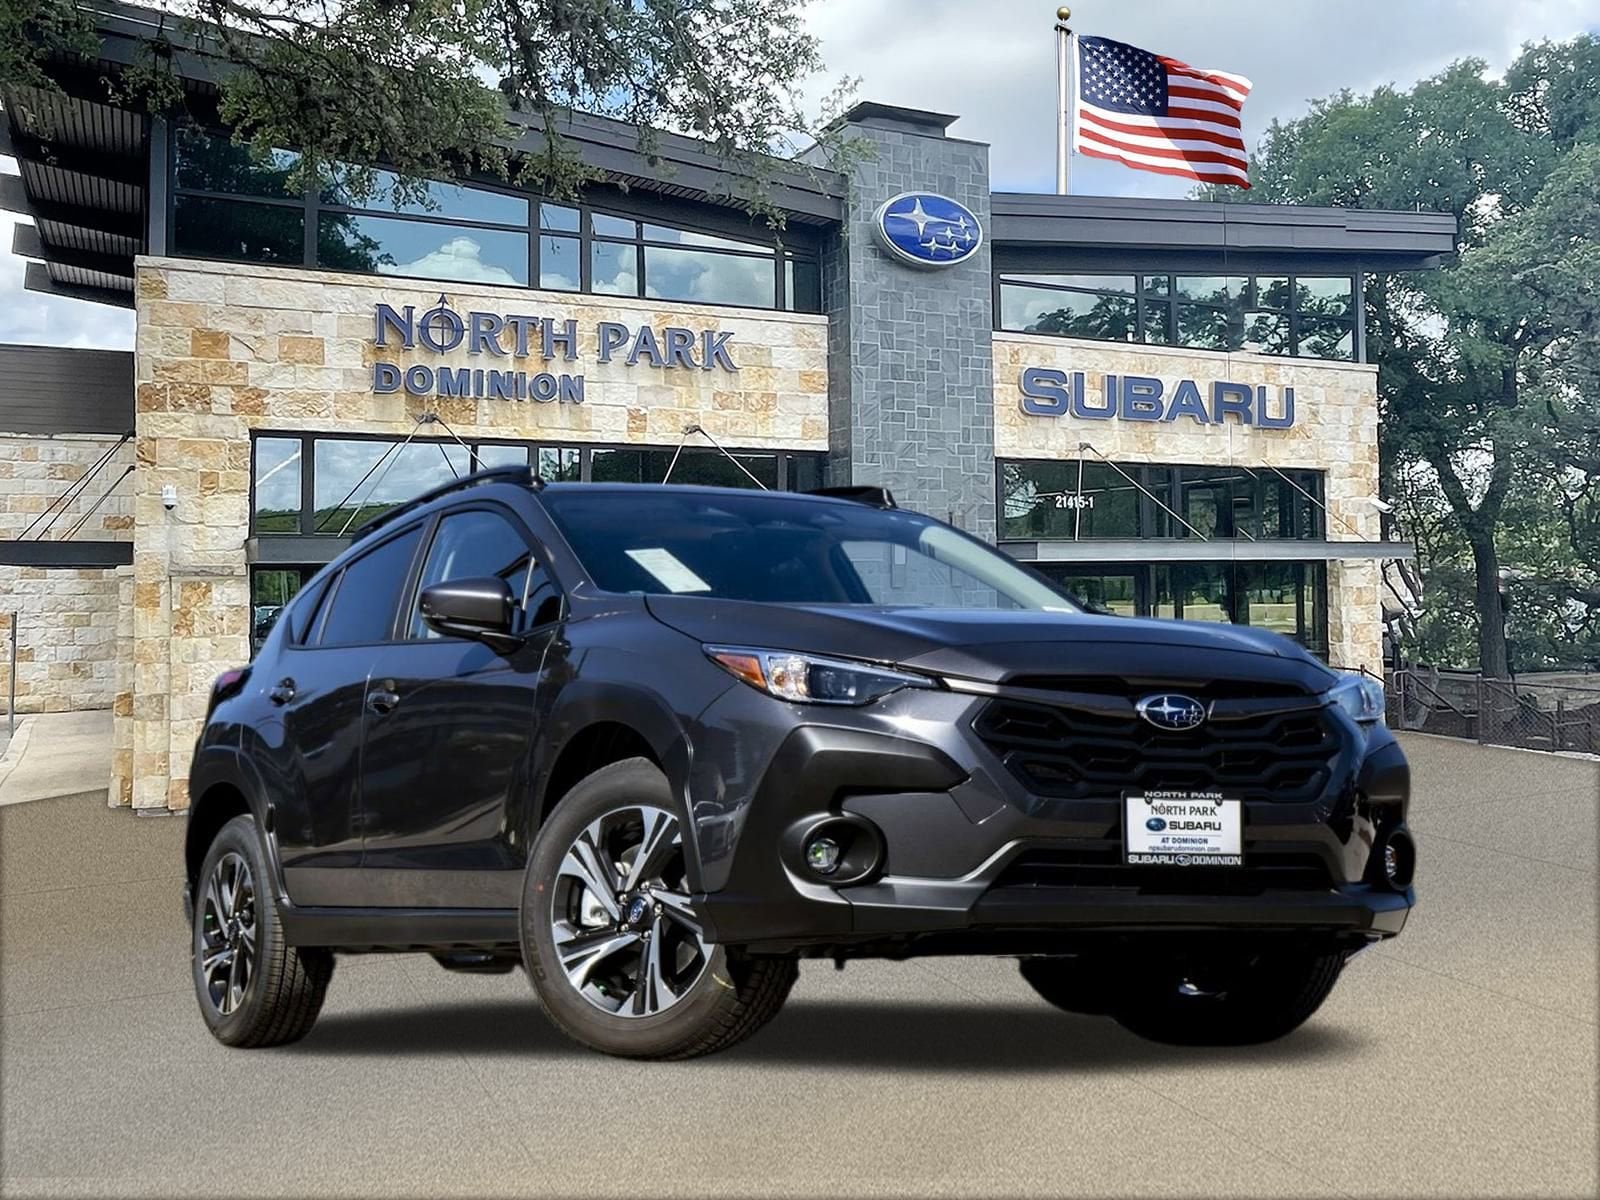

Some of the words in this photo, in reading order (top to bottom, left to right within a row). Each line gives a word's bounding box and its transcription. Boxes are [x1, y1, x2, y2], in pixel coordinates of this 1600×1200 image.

[375, 299, 579, 361] NORTH
[597, 321, 741, 372] PARK
[373, 362, 585, 403] DOMINION
[1019, 367, 1294, 429] SUBARU
[1055, 495, 1094, 509] 21415-1
[1144, 791, 1187, 799] NORTH
[1190, 792, 1223, 800] PARK
[1151, 803, 1186, 816] NORTH
[1189, 806, 1217, 816] PARK
[1169, 821, 1221, 831] SUBARU
[1171, 837, 1208, 845] DOMINION
[1128, 855, 1174, 865] SUBARU
[1192, 855, 1241, 866] DOMINION
